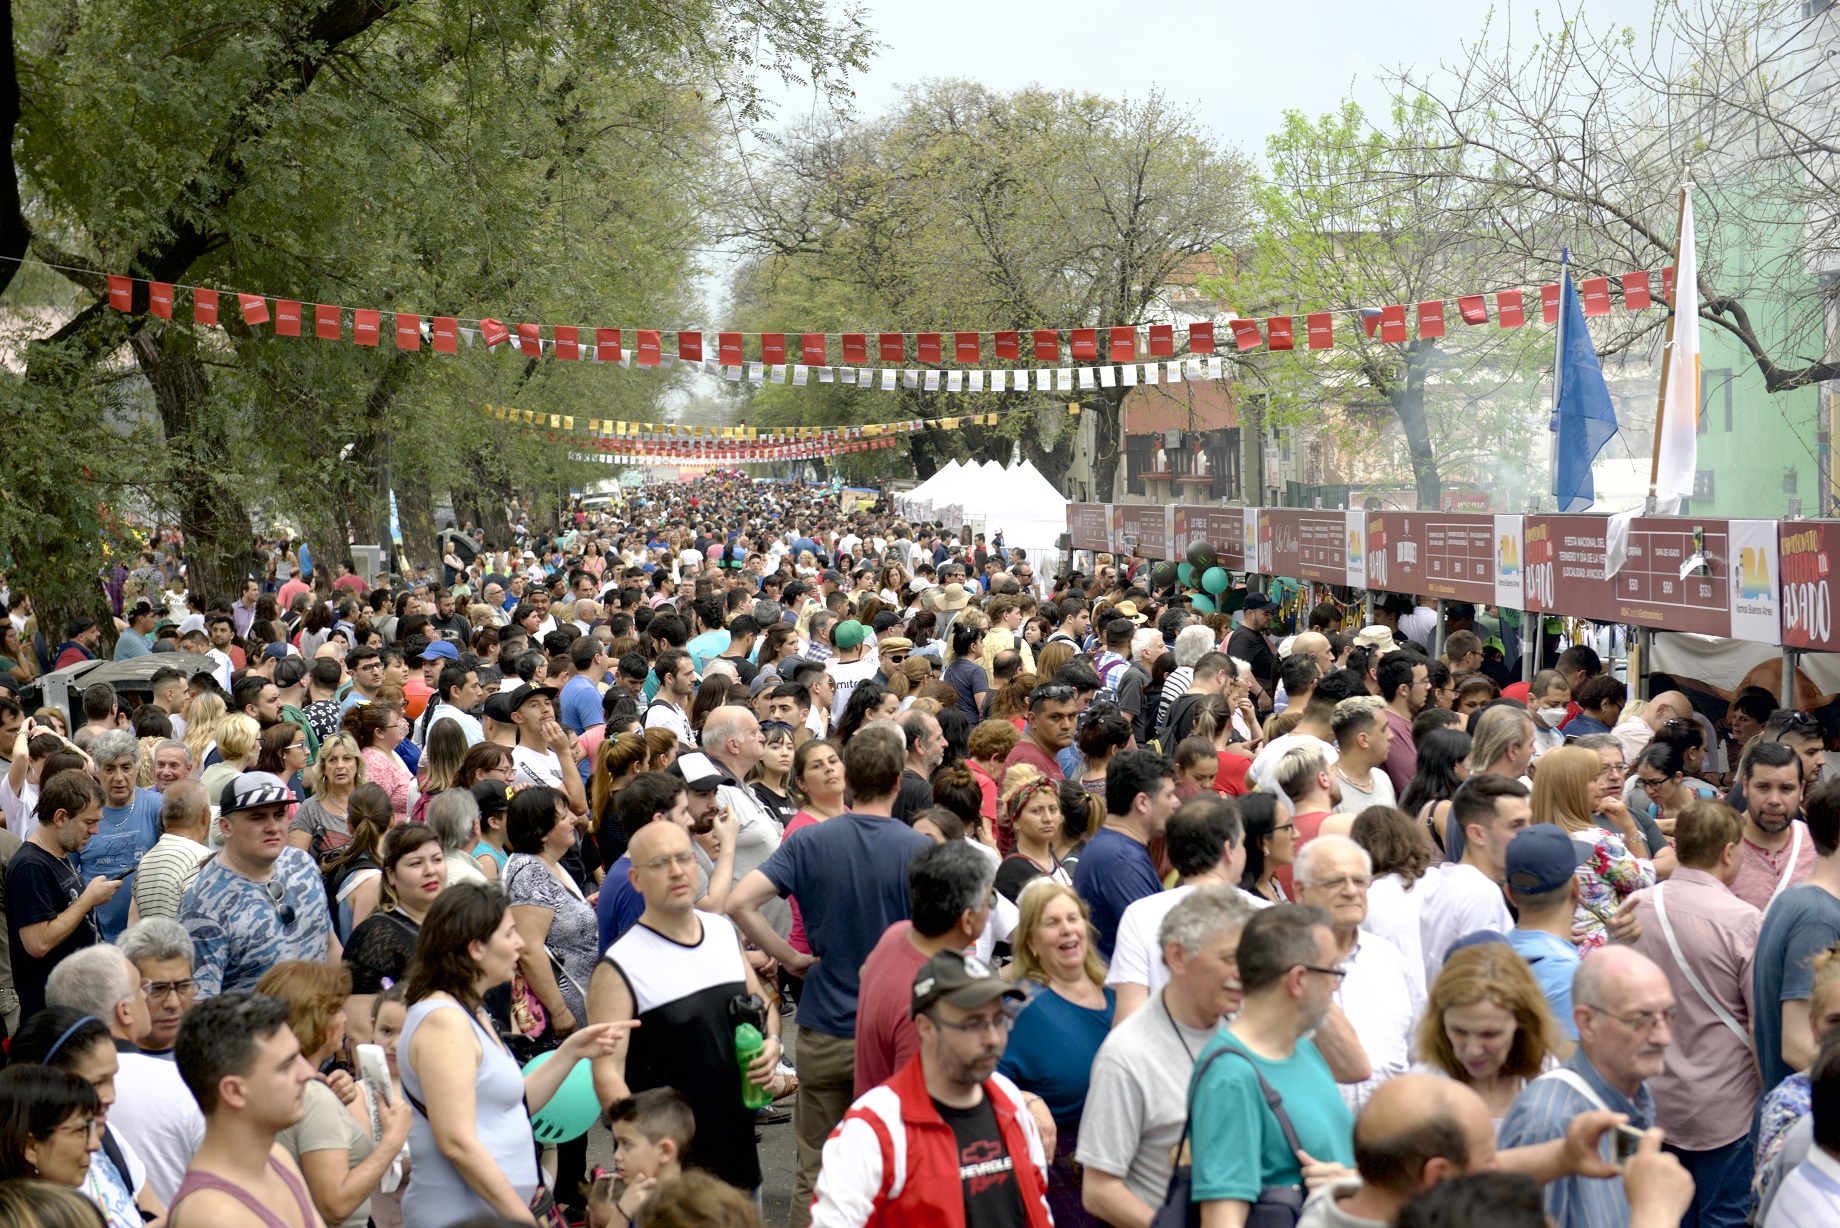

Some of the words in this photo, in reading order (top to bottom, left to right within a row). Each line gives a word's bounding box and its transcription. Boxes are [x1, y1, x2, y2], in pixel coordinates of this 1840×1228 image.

[1781, 529, 1818, 556] CAMPEONATO
[1627, 544, 1642, 557] ORIPÁN
[1526, 561, 1554, 609] ASADO
[1629, 578, 1638, 591] $50
[1663, 580, 1673, 594] $90
[1736, 604, 1748, 613] Vamos
[1748, 604, 1762, 615] Buenos
[1762, 605, 1773, 617] Aires
[1783, 580, 1831, 643] ASADO
